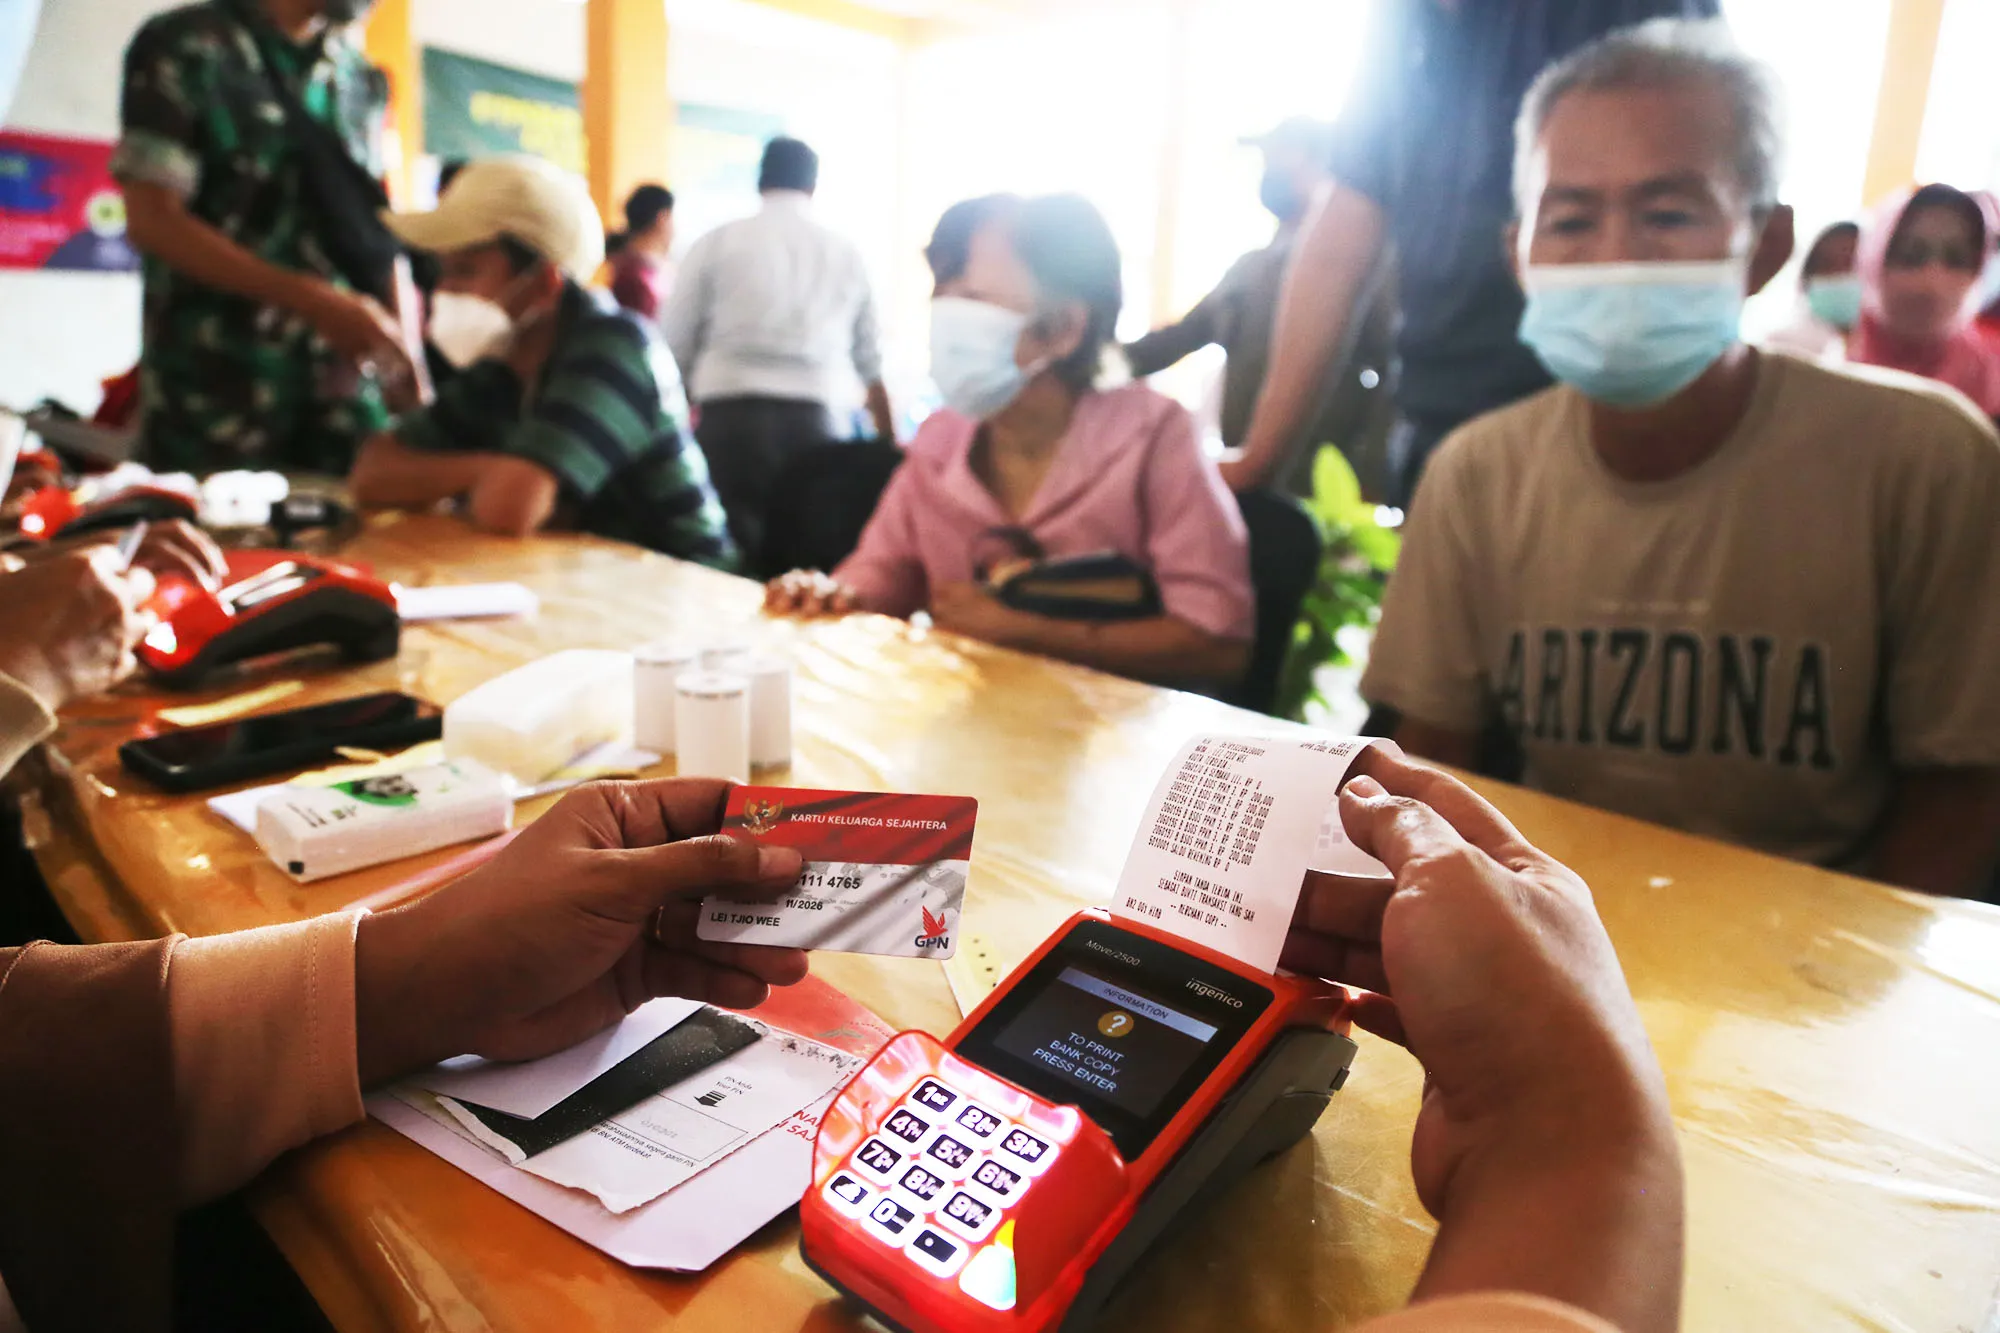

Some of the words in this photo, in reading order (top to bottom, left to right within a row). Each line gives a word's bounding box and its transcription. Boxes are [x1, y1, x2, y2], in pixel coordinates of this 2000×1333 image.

[1499, 628, 1835, 769] ARIZONA
[1240, 788, 1248, 798] RP
[1251, 792, 1274, 806] 200,000
[1235, 799, 1244, 810] RP
[1246, 803, 1270, 818] 200,000
[790, 813, 826, 824] KARTU
[828, 815, 883, 827] KELUARGA
[886, 818, 947, 830] SEJAHTERA
[1230, 810, 1238, 820] RP
[1242, 814, 1265, 830] 200,000
[1226, 822, 1234, 832] RP
[1236, 826, 1260, 842] 200,000
[1221, 834, 1230, 844] RP
[1232, 838, 1256, 854] 200,000
[1217, 846, 1226, 856] RP
[1228, 850, 1252, 866] 200,000
[795, 874, 822, 888] 111
[827, 876, 860, 890] 4765
[1173, 870, 1193, 886] SIMPAN
[1194, 876, 1210, 892] TANDA
[1211, 882, 1231, 899] TERIMA
[1232, 889, 1244, 904] INI
[786, 899, 824, 911] 11/2026
[1158, 878, 1180, 895] SEBAGAI
[1180, 886, 1198, 901] BUKTI
[1198, 891, 1228, 912] TRANSAKSI
[1228, 902, 1242, 918] YANG
[710, 912, 728, 922] LEI
[730, 914, 754, 924] TJIO
[756, 916, 780, 927] WEE
[1178, 904, 1204, 922] MERCHANT
[1204, 912, 1219, 926] COPY
[914, 934, 950, 950] GPN
[1086, 940, 1141, 967] Move/2500
[1185, 978, 1244, 1009] ingenico
[1104, 988, 1169, 1020] INFORMATION
[1069, 1032, 1086, 1046] TO
[1087, 1039, 1124, 1062] PRINT
[1050, 1040, 1084, 1060] BANK
[1084, 1056, 1122, 1077] COPY
[1032, 1048, 1075, 1072] PRESS
[1074, 1068, 1118, 1093] ENTER
